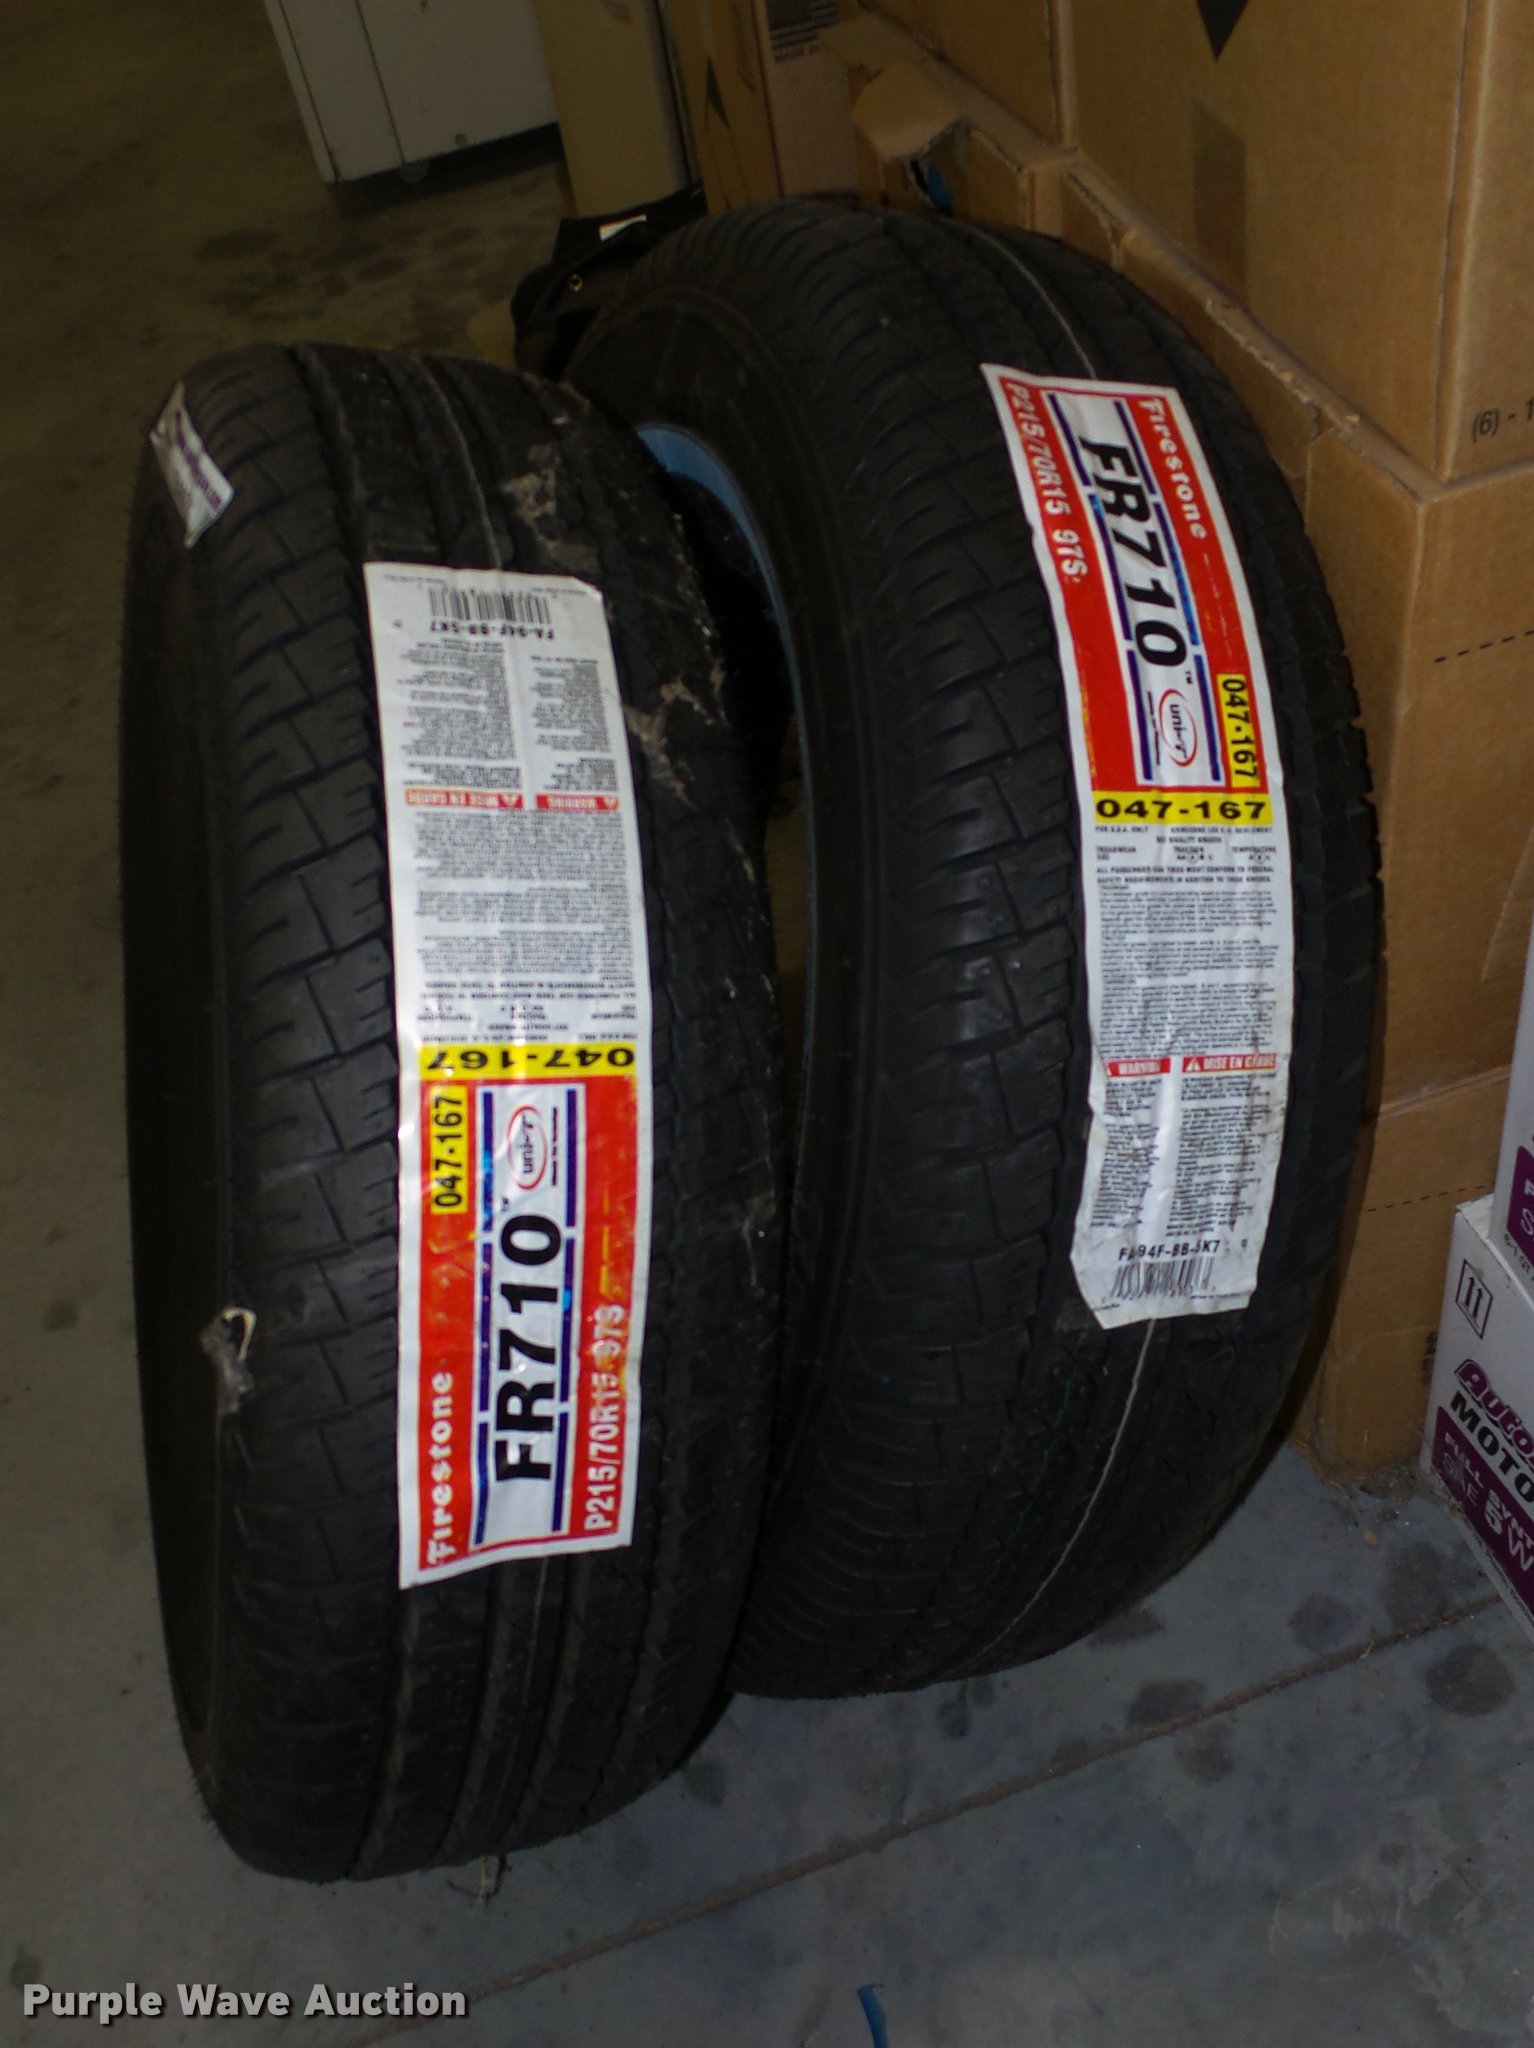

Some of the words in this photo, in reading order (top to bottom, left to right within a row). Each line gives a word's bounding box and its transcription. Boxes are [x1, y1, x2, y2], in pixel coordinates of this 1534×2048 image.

[1004, 382, 1072, 516] P215/70R15
[1052, 528, 1089, 577] 97S
[1079, 435, 1187, 667] FR710
[1139, 398, 1207, 539] Firestone
[1096, 798, 1266, 819] 047-167
[427, 1048, 634, 1070] 047-167
[495, 1214, 562, 1481] FR710
[427, 1371, 457, 1565] Firestone
[584, 1372, 620, 1531] P215/70R15
